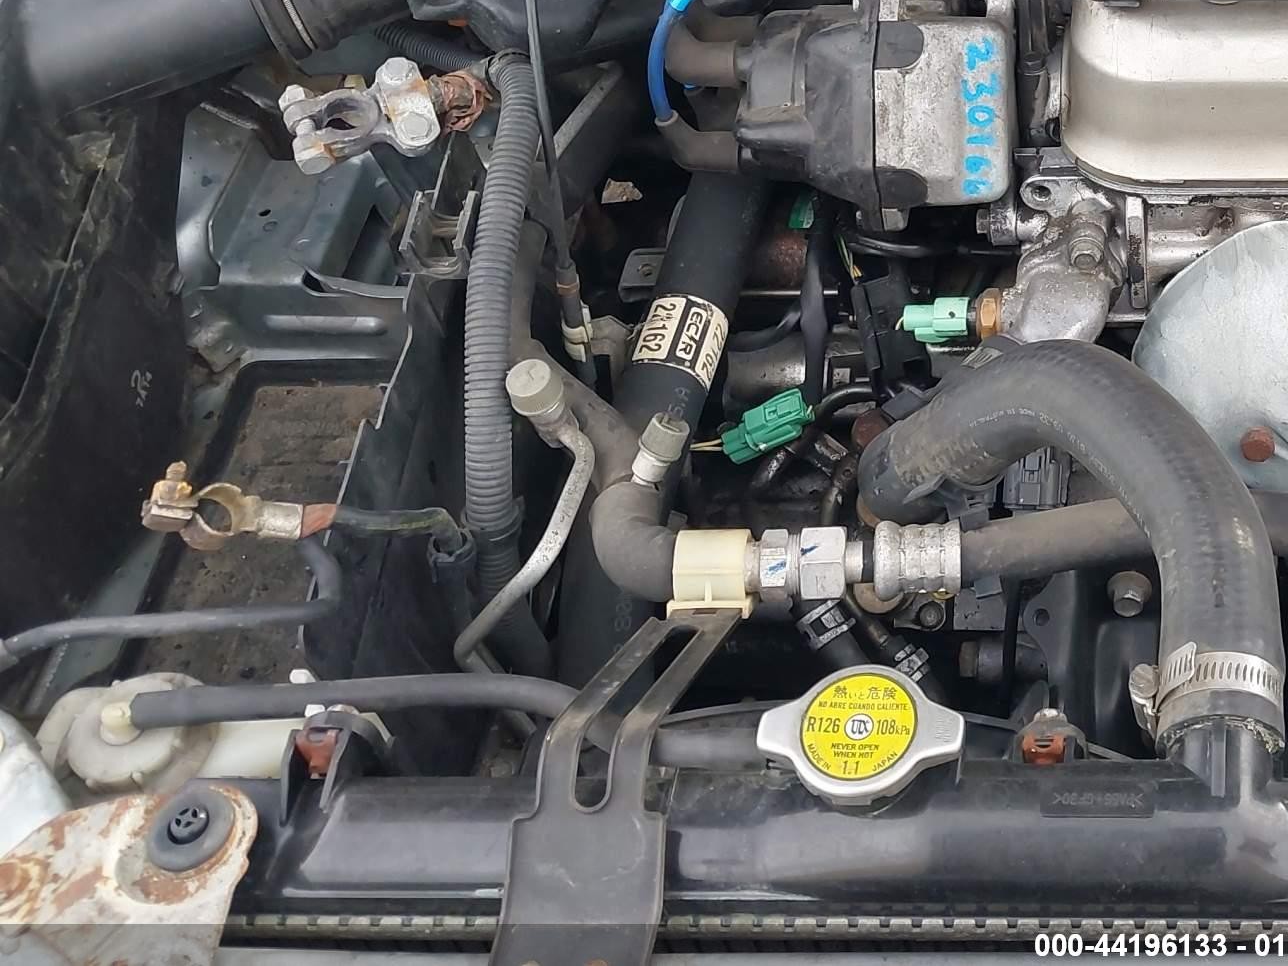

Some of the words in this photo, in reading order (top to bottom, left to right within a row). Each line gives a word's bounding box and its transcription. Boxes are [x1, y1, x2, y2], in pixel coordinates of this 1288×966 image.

[832, 686, 898, 700] 熱いと危険
[806, 716, 841, 734] R126
[808, 744, 822, 764] MADE
[822, 762, 831, 770] IN
[872, 751, 898, 772] JAPAN
